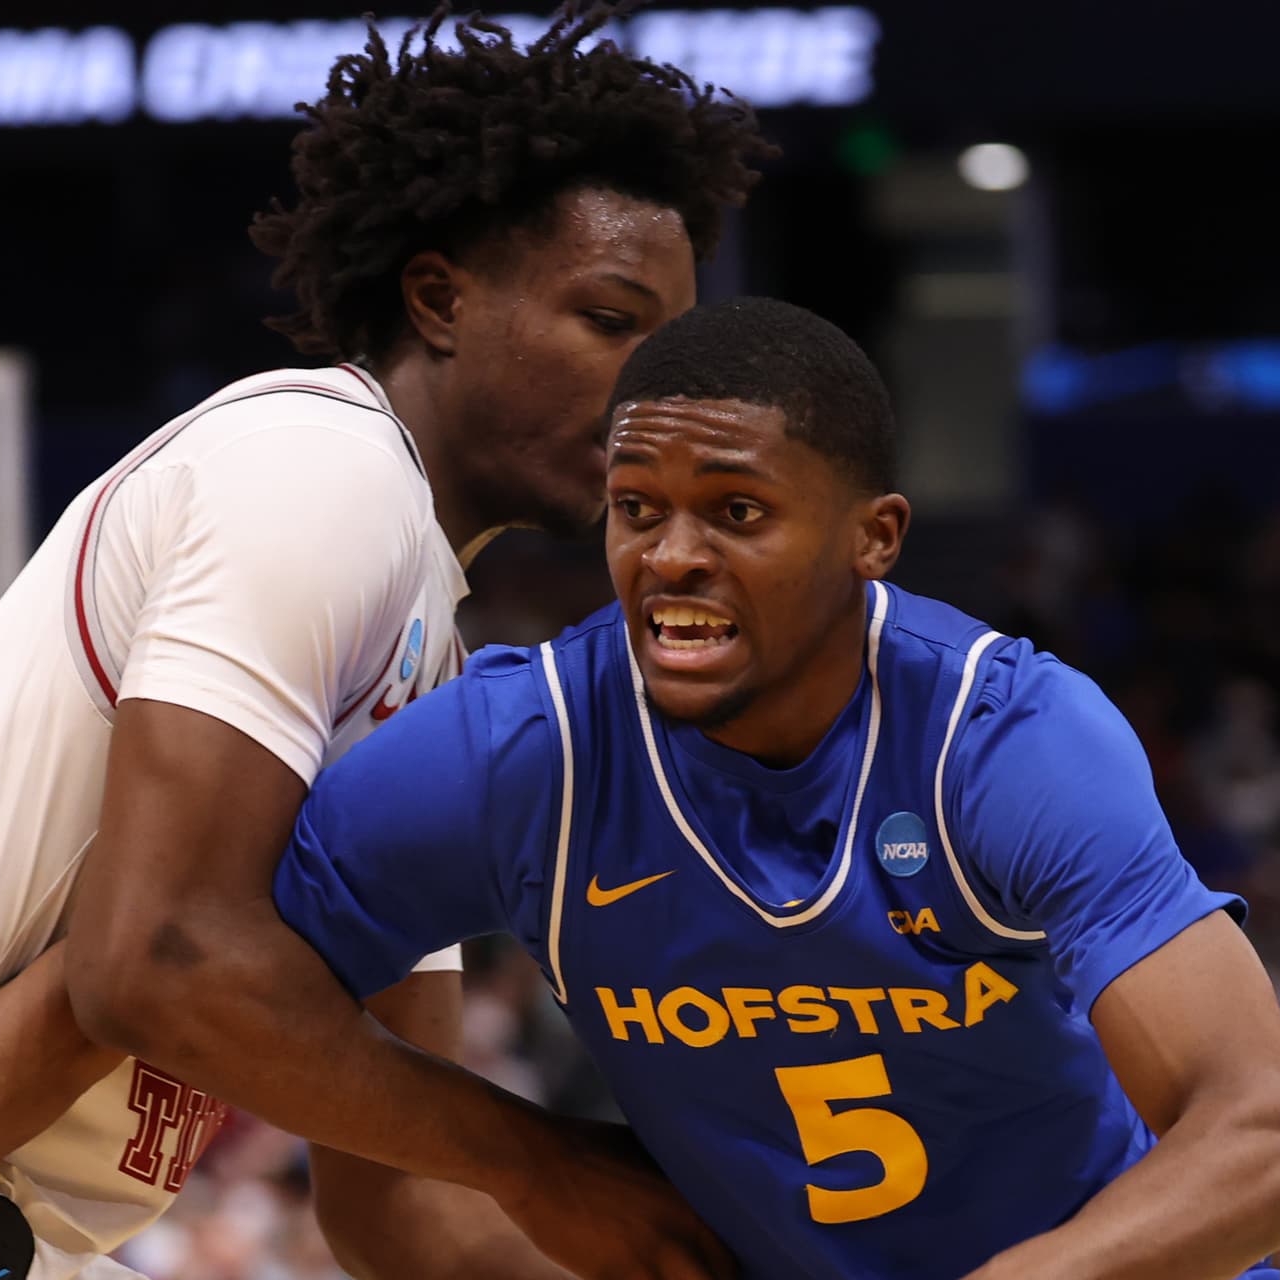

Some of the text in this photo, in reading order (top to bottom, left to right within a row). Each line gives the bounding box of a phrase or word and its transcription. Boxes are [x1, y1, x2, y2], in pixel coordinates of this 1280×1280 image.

[882, 841, 928, 861] NCAA
[594, 961, 1019, 1048] HOFSTRA
[774, 1053, 928, 1224] 5
